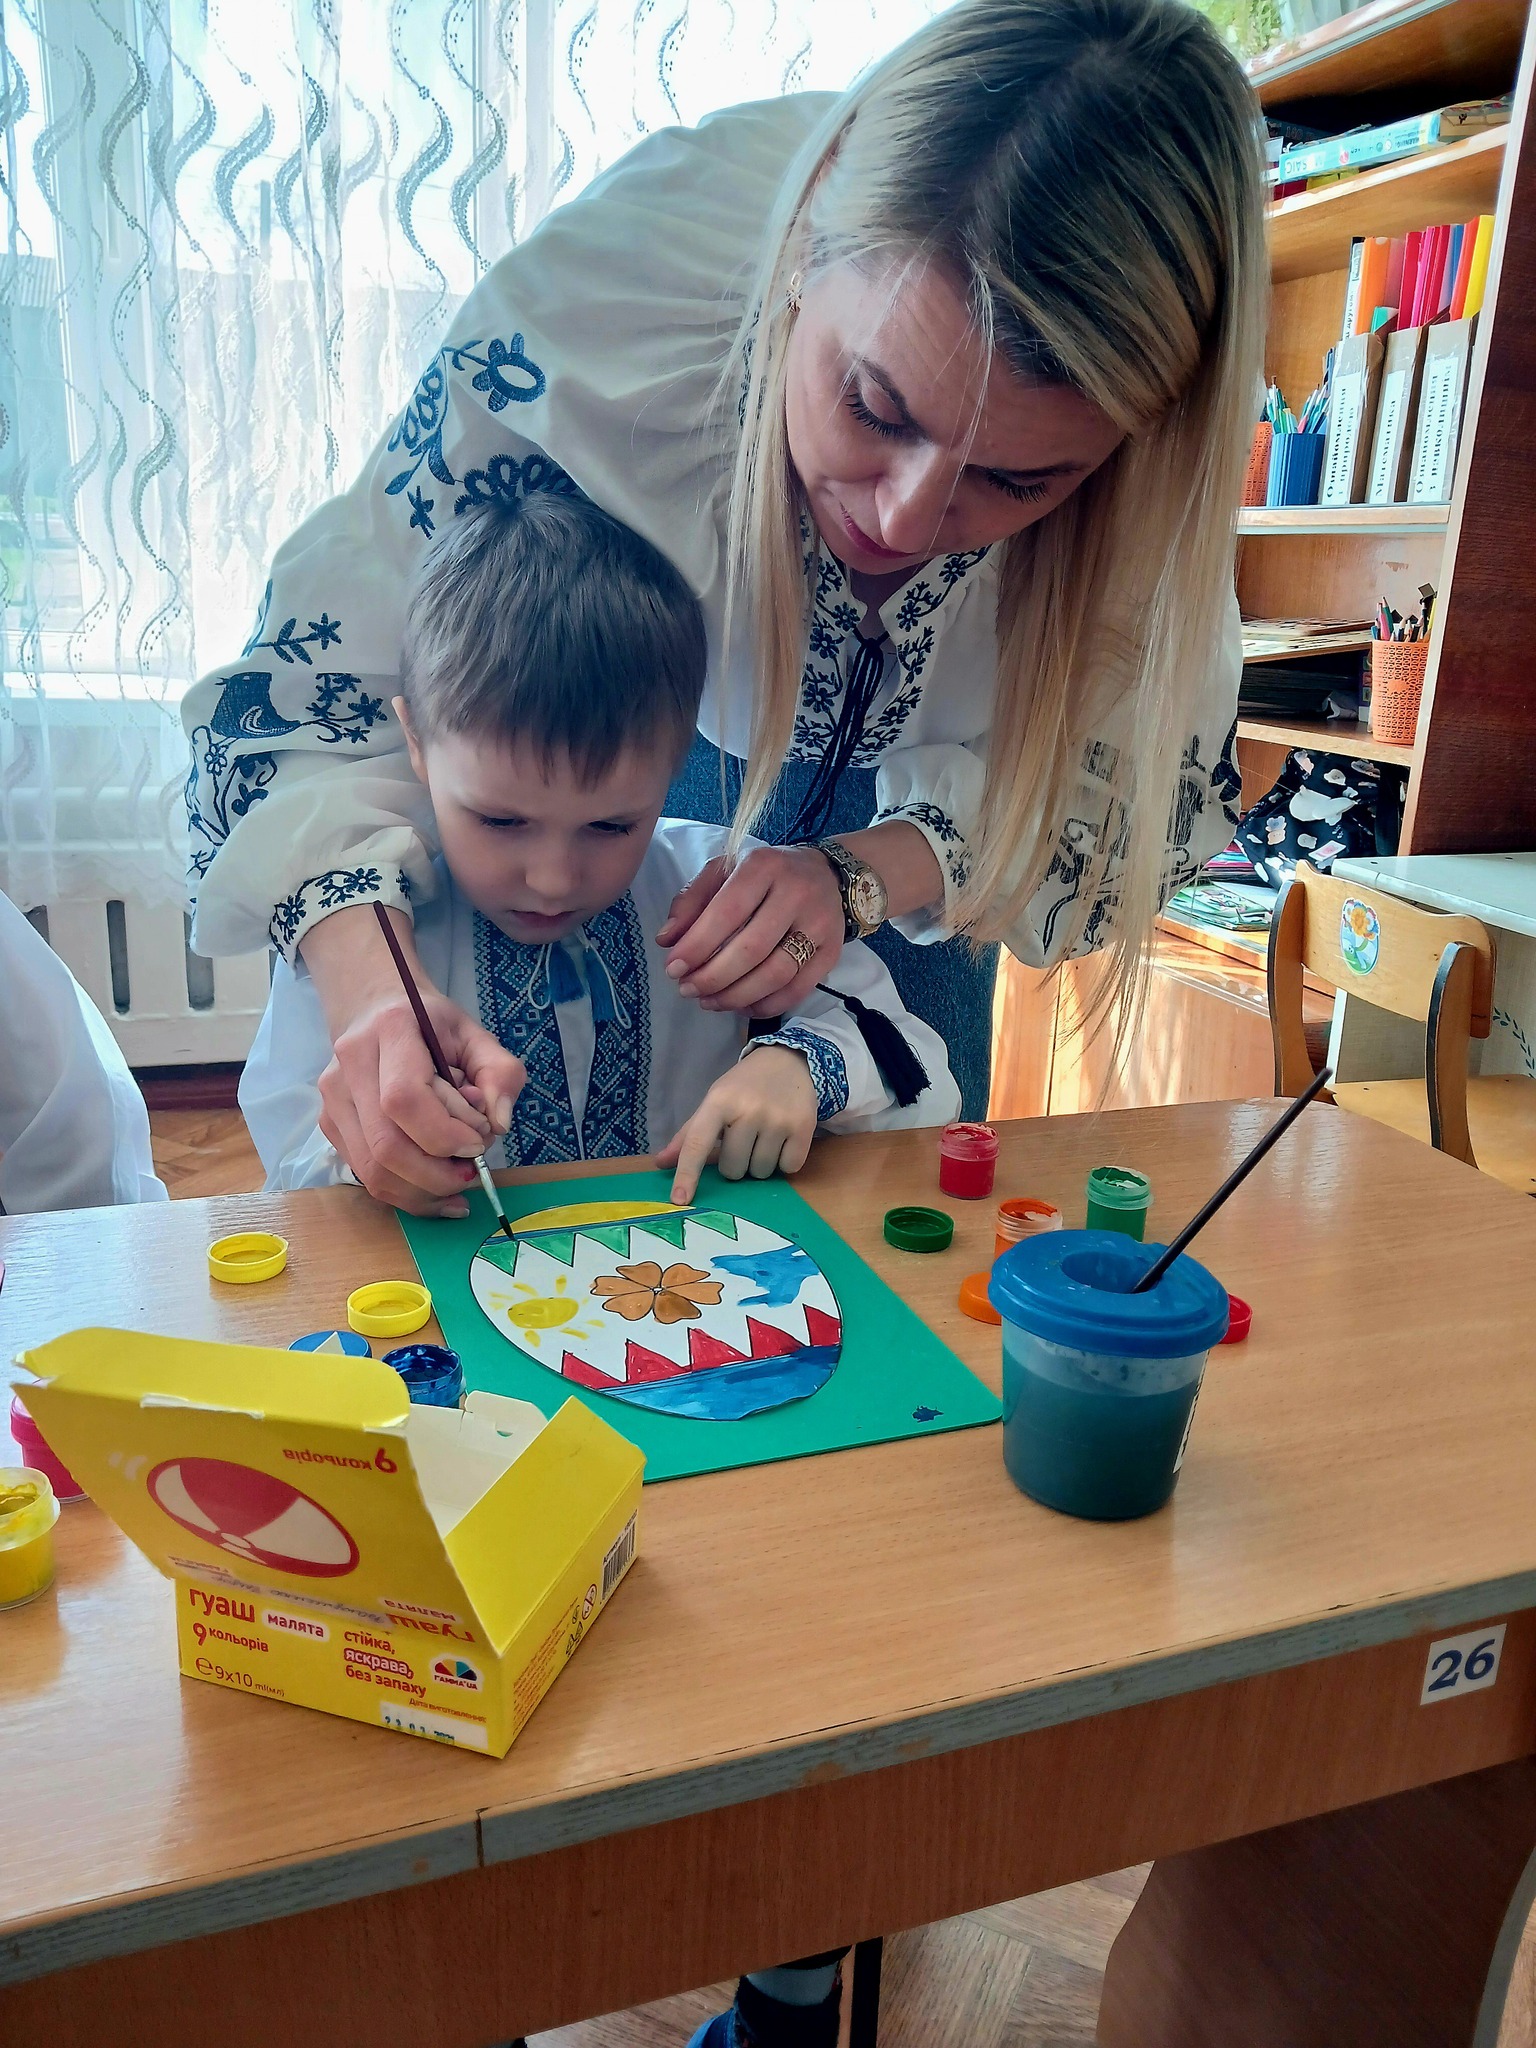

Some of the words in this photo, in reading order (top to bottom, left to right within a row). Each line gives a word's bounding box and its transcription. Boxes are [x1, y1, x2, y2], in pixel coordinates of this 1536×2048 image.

[282, 1449, 372, 1471] кольорів
[375, 1447, 398, 1474] 9
[189, 1588, 255, 1623] гуаш
[267, 1613, 324, 1638] малята
[384, 1599, 456, 1621] малята
[192, 1622, 207, 1646] 9
[208, 1627, 269, 1652] кольорів
[344, 1631, 395, 1655] стійка,
[385, 1613, 475, 1643] гуаш
[344, 1648, 414, 1679] яскрава,
[1428, 1639, 1496, 1693] 26
[345, 1664, 372, 1682] без
[375, 1674, 427, 1698] запаху
